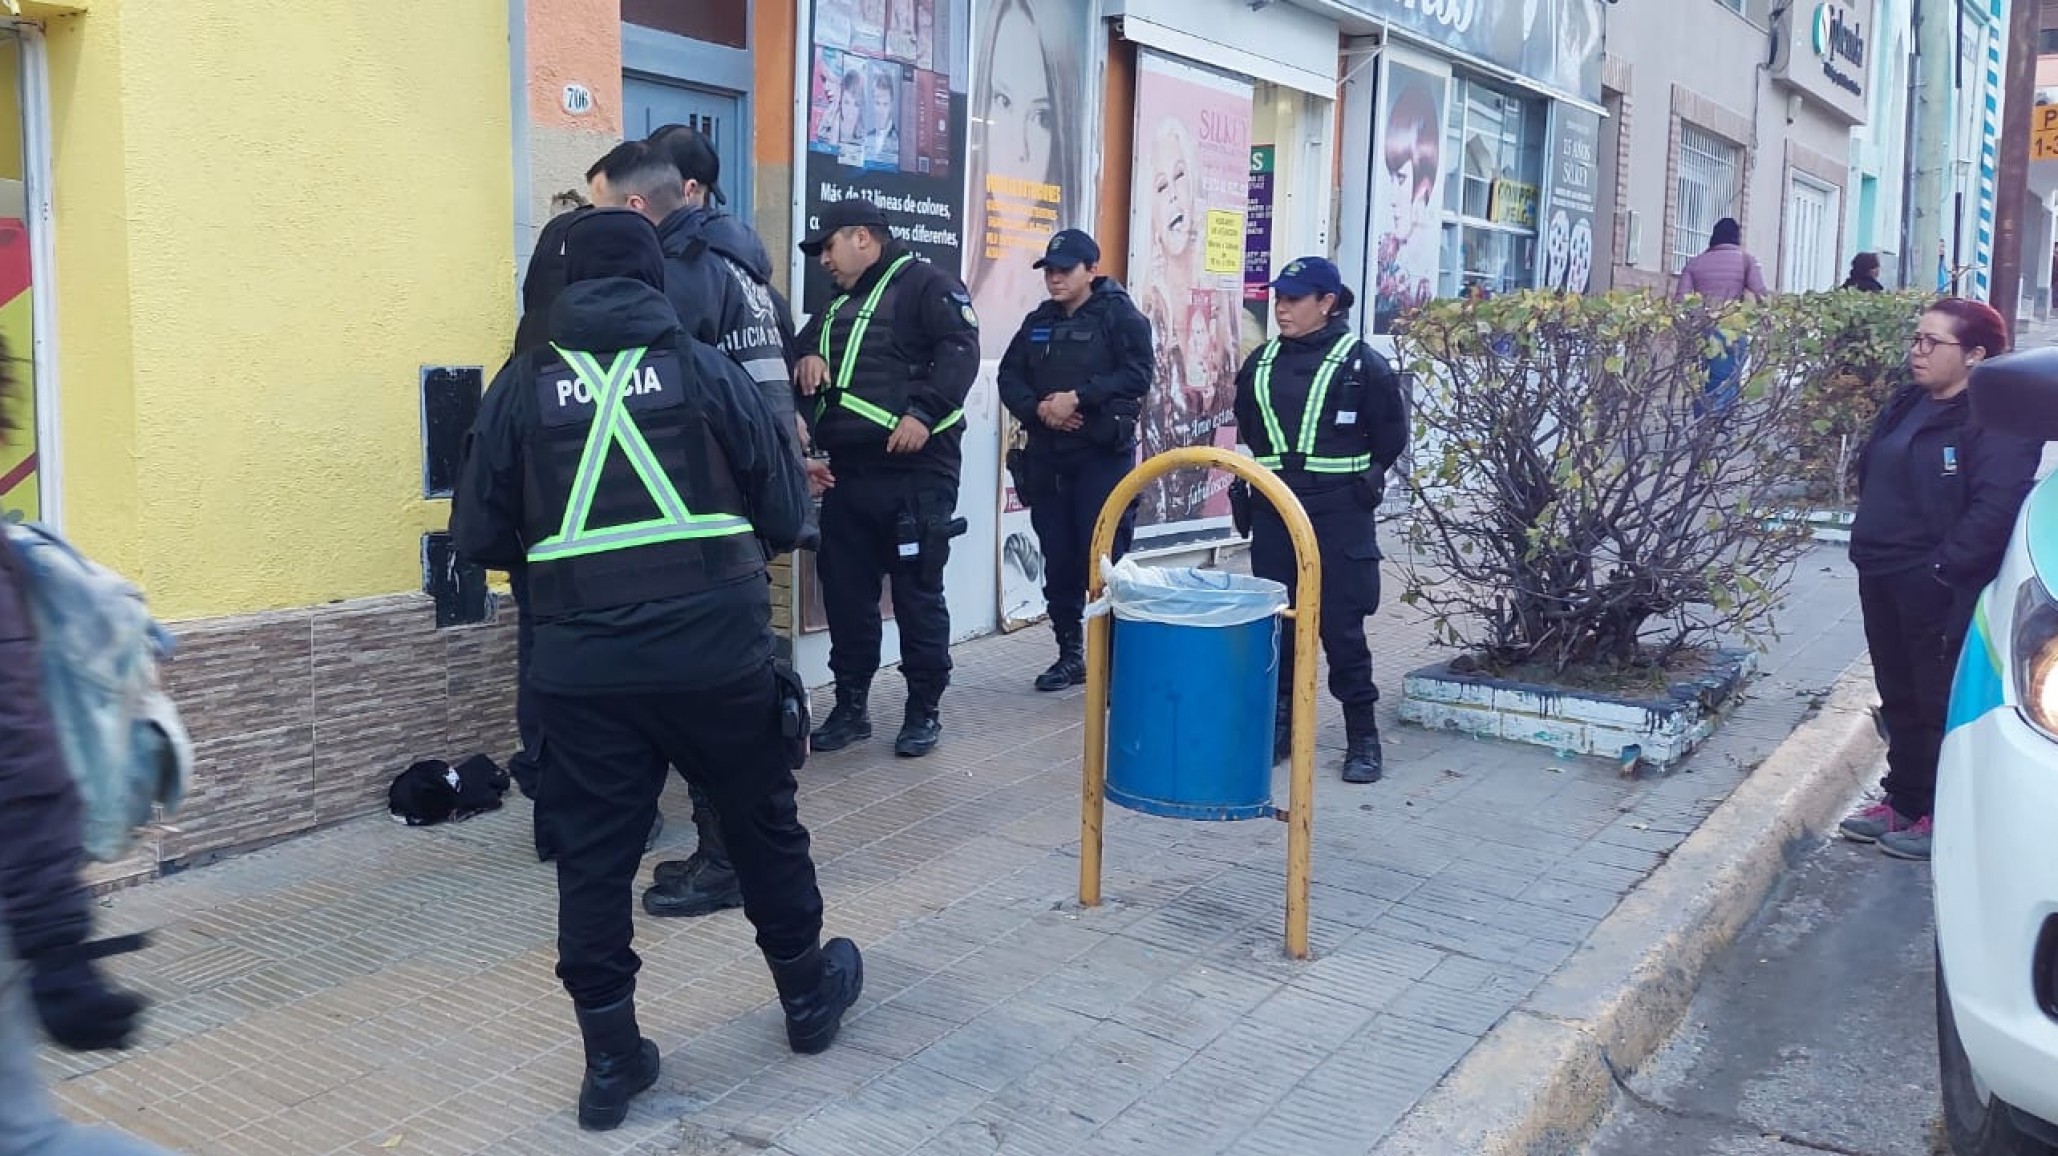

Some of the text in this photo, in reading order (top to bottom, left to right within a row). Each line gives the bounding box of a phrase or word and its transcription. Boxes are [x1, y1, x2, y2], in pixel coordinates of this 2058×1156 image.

[567, 87, 588, 109] 706
[820, 182, 843, 203] Más
[903, 193, 917, 213] de
[556, 366, 662, 407] POIA
